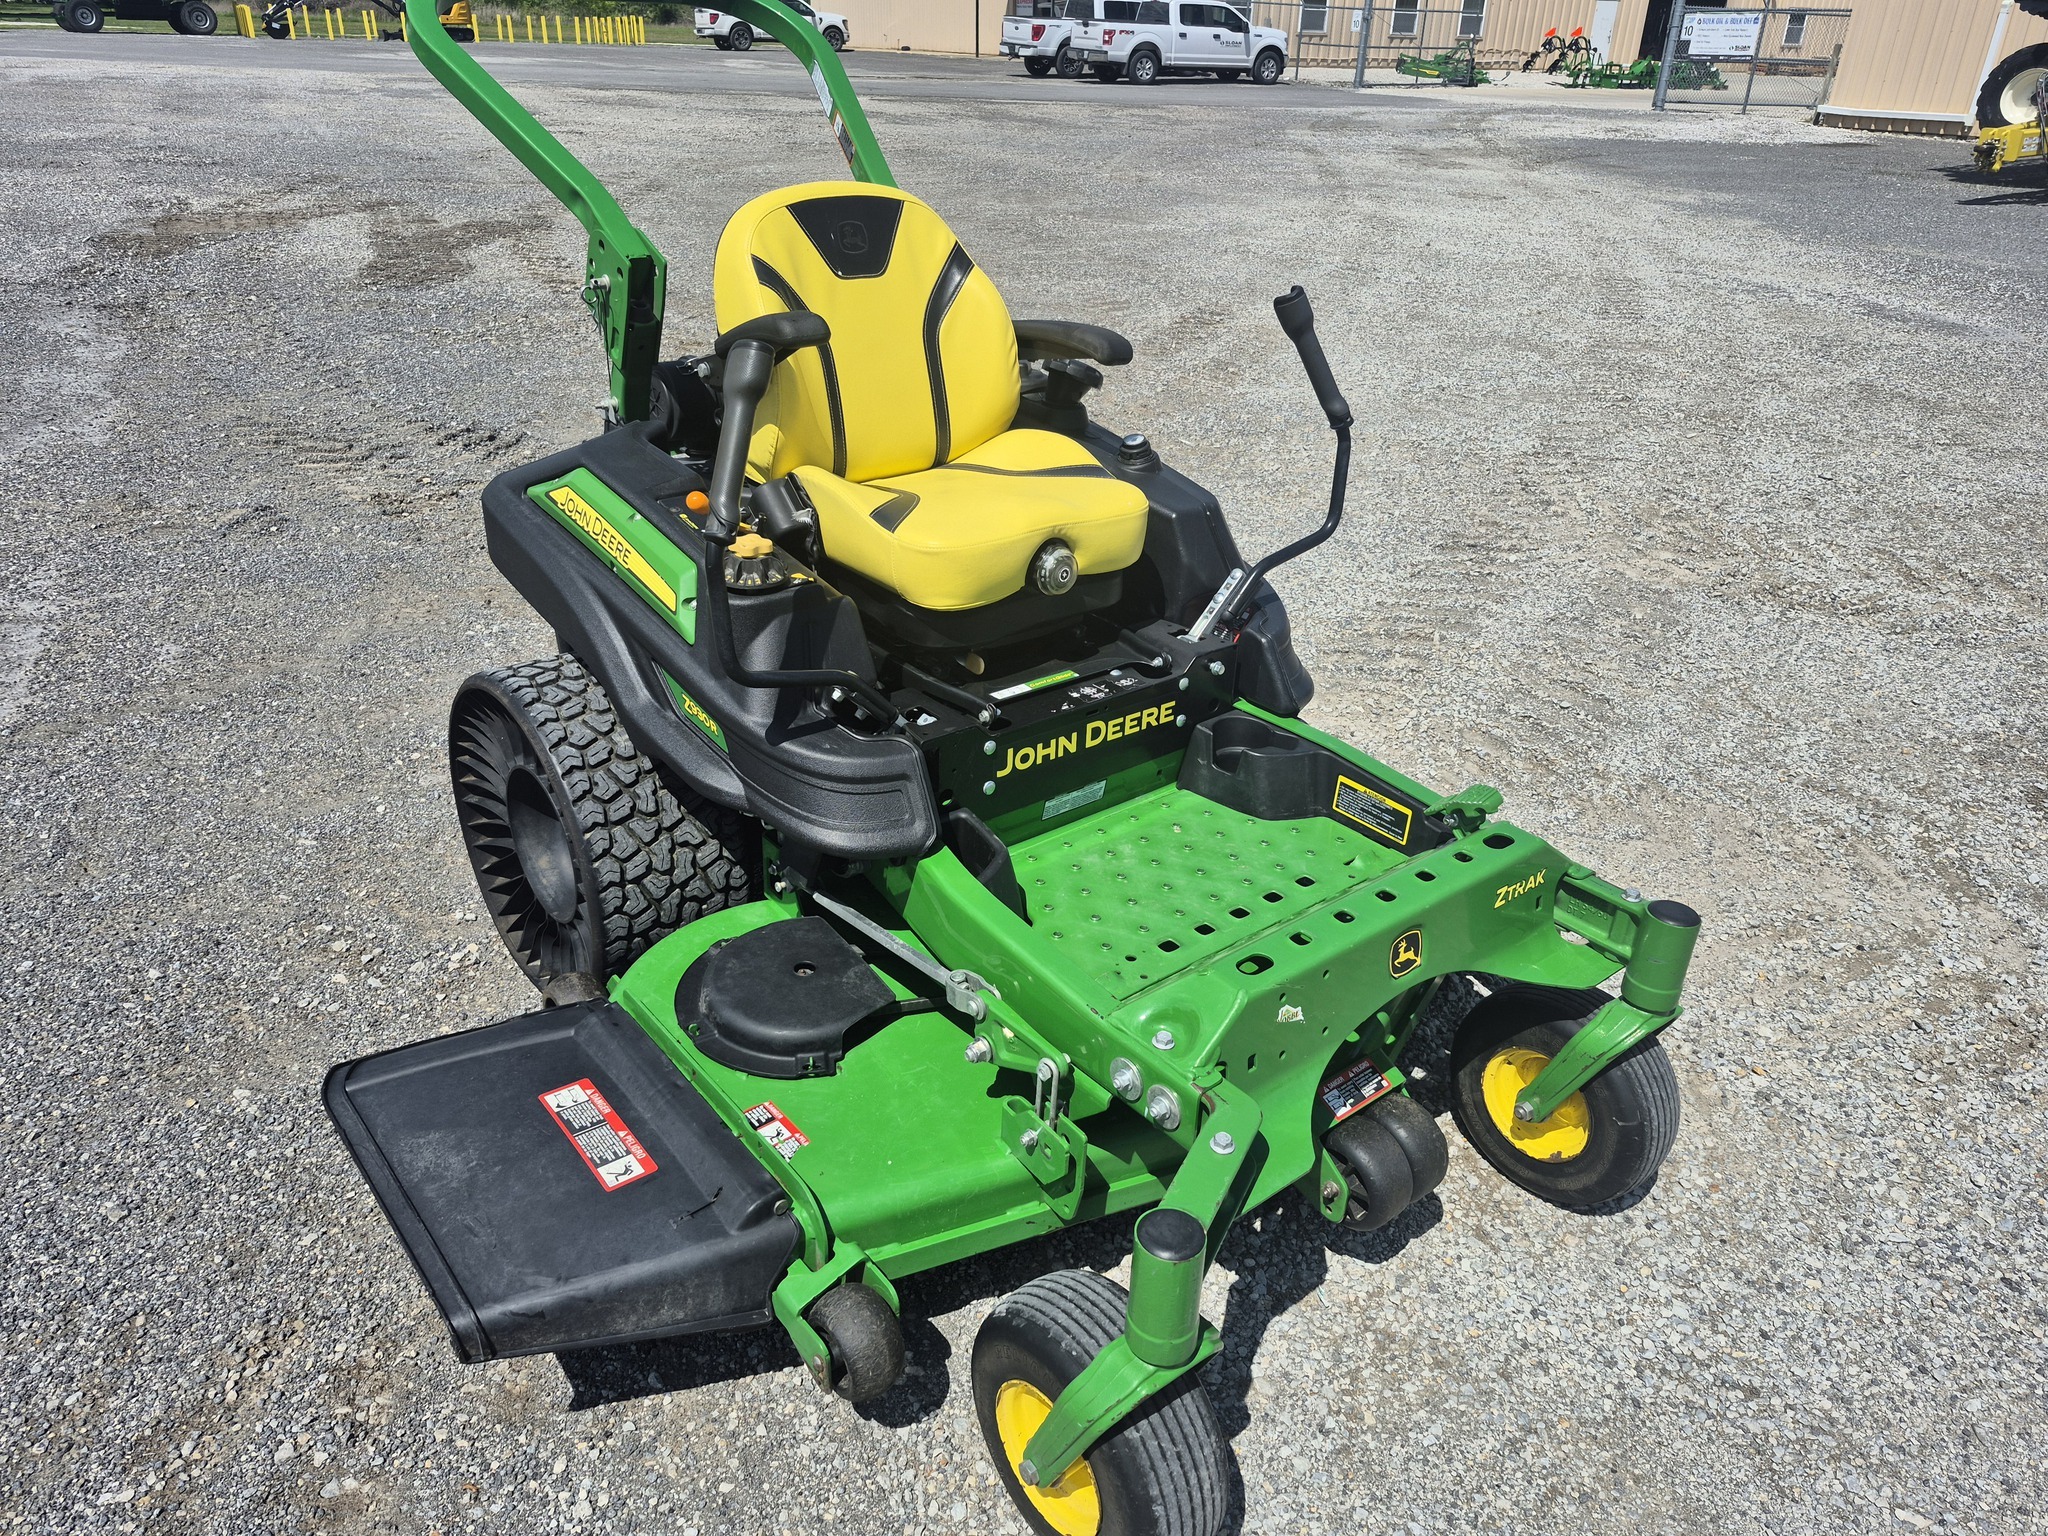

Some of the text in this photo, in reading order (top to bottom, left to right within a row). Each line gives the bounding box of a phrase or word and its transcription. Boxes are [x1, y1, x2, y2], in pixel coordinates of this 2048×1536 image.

[1684, 25, 1694, 36] 10
[560, 491, 592, 529] JOHN
[592, 516, 632, 566] DEERE
[996, 700, 1177, 778] JOHN DEERE
[1493, 867, 1547, 910] ZTRAK
[1353, 1061, 1370, 1074] PELIGRO
[1329, 1076, 1345, 1089] DANGER
[590, 1093, 610, 1115] DANGER
[766, 1103, 784, 1120] DANGER
[624, 1135, 646, 1160] PELIGRO
